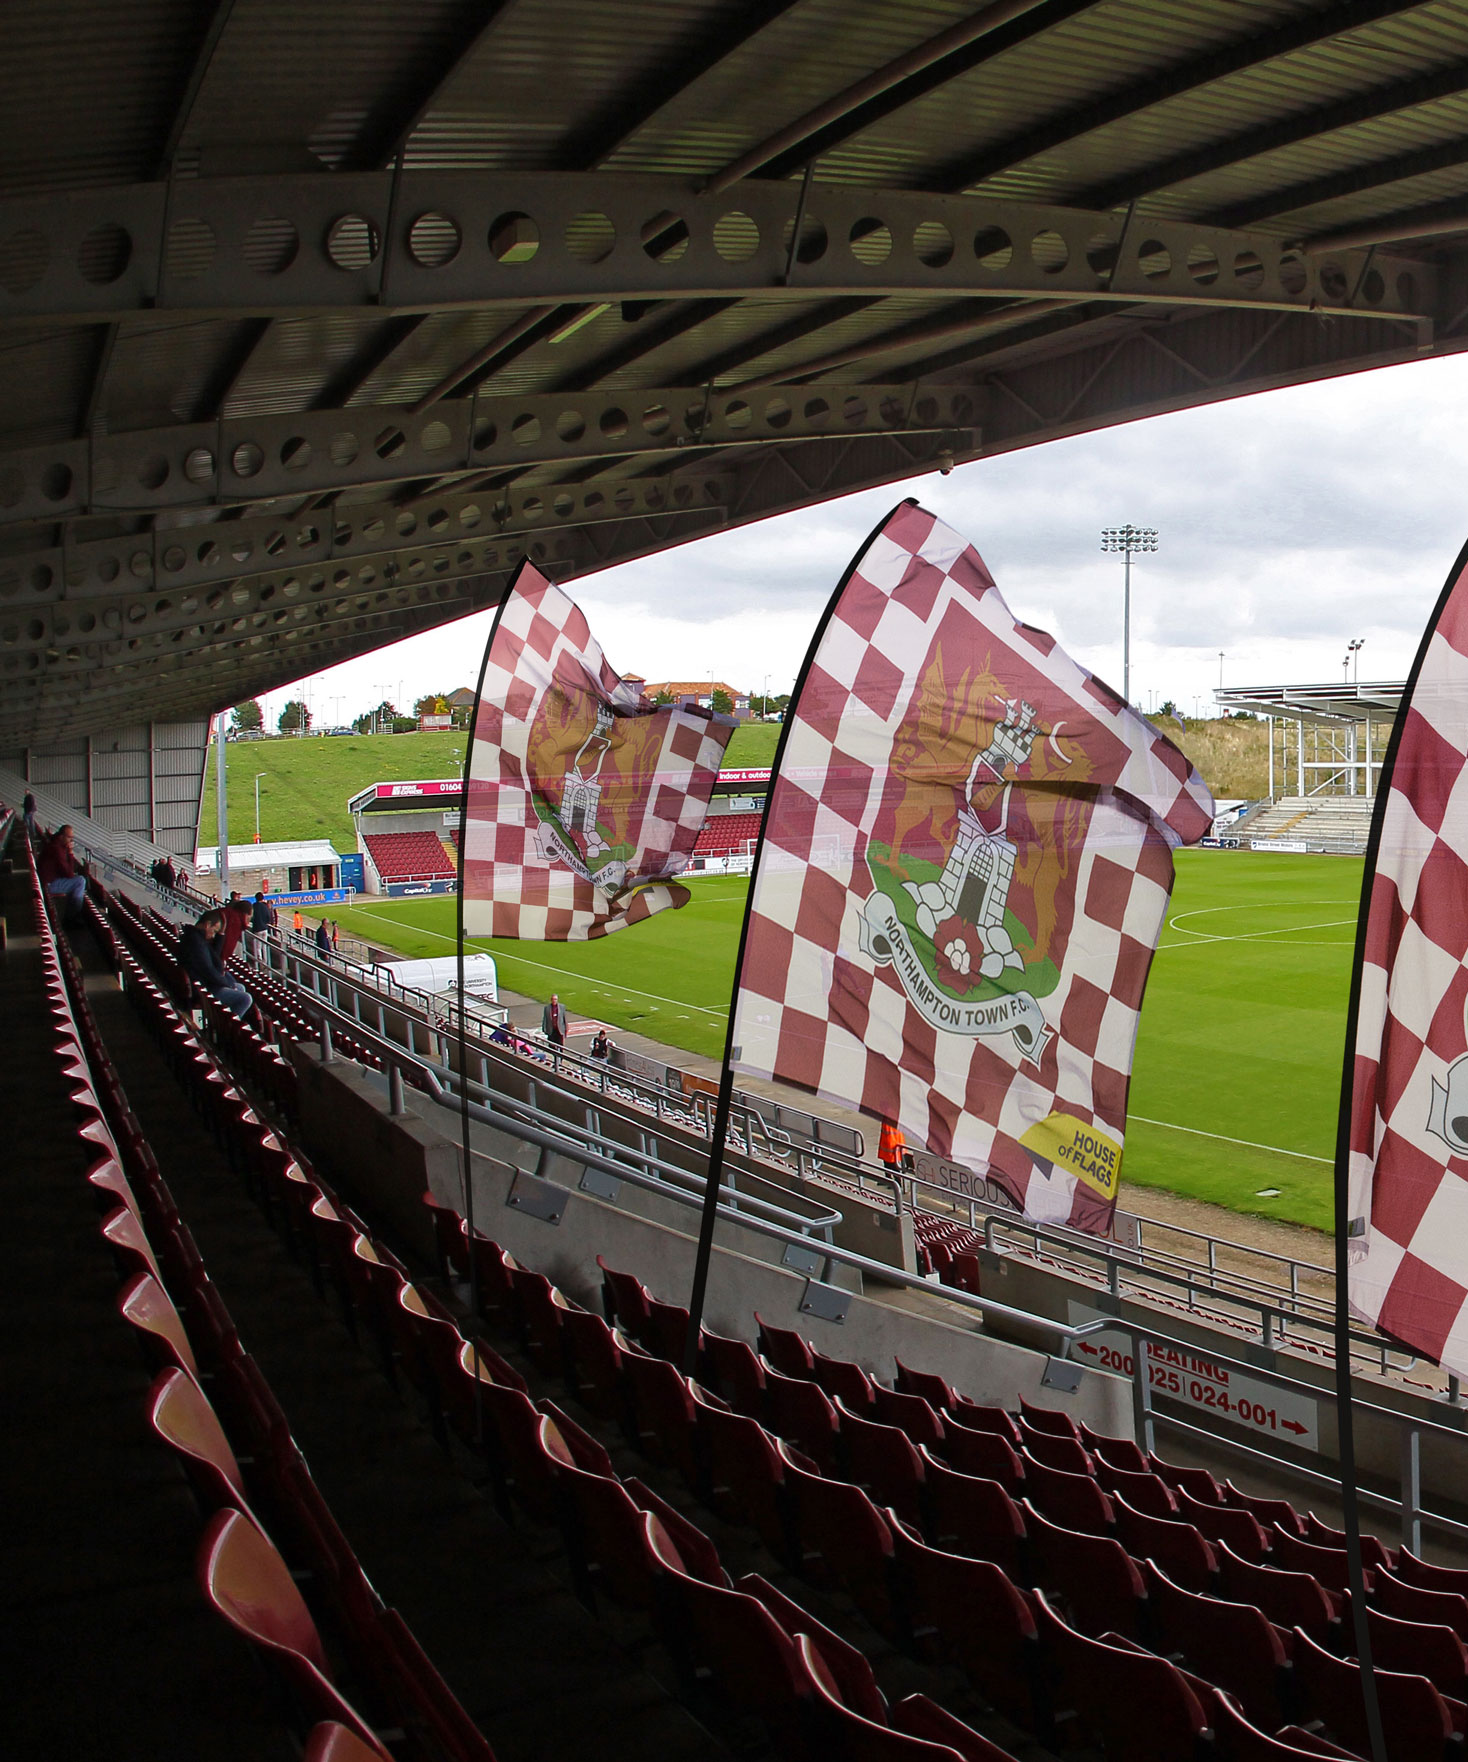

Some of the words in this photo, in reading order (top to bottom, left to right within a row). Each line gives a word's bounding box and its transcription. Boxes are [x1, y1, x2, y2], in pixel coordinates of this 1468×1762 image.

[440, 783, 462, 791] 01604
[719, 772, 740, 780] Indoor
[748, 771, 771, 779] outdoo
[884, 915, 962, 1026] NORTHAMPTON
[965, 1004, 1009, 1026] TOWN
[1011, 998, 1030, 1017] F.C.
[1058, 1145, 1074, 1160] of
[1072, 1150, 1112, 1188] FLAGS
[1073, 1130, 1116, 1169] HOUSE
[1190, 1380, 1278, 1430] 024-001
